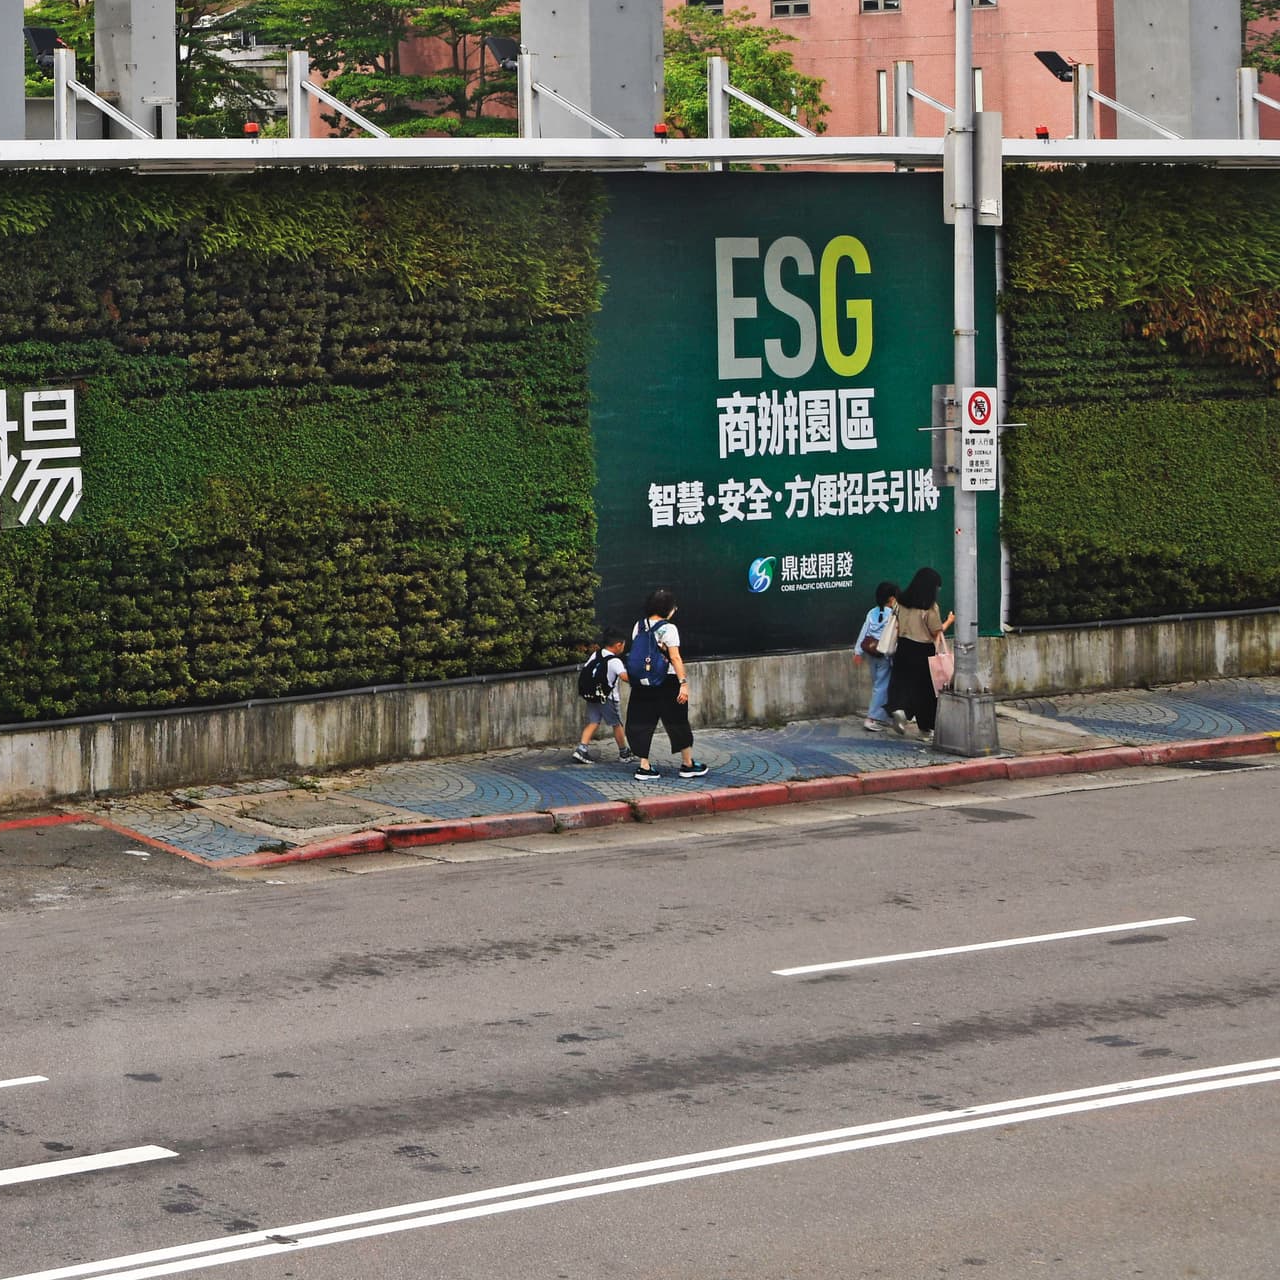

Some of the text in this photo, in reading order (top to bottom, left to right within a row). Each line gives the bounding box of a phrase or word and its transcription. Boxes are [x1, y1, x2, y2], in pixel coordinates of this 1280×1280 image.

[714, 234, 873, 380] ESG
[716, 387, 878, 459] 商辦園區
[780, 580, 853, 592] CORE PACIFIC DEVELOPMENT
[781, 551, 854, 581] 鼎越開發
